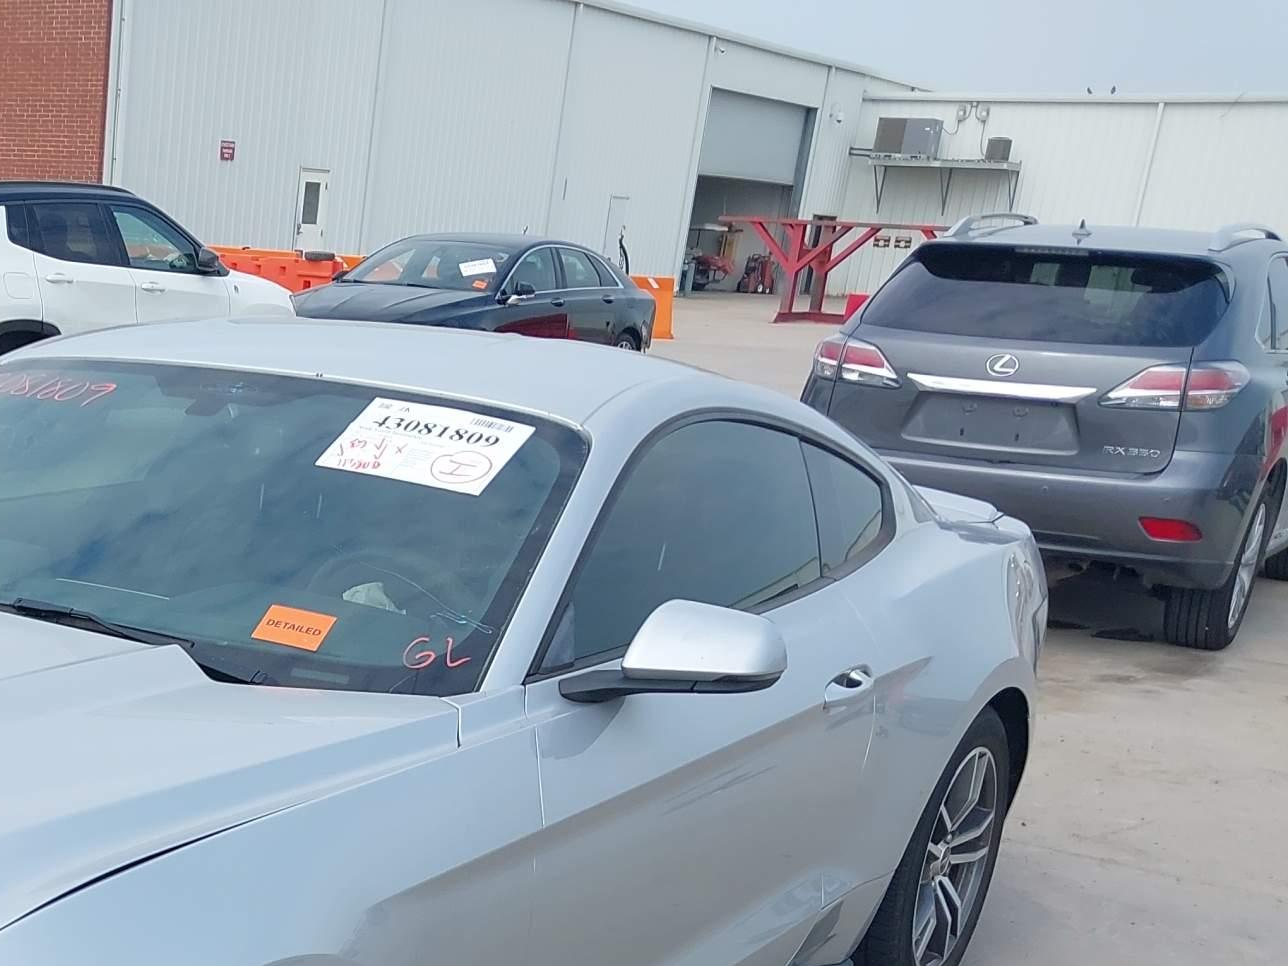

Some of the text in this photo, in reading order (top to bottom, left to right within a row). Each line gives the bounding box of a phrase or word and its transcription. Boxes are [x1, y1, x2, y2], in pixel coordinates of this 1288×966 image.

[373, 416, 500, 448] 43081809
[1103, 446, 1126, 456] RX
[265, 617, 322, 637] DETAILED
